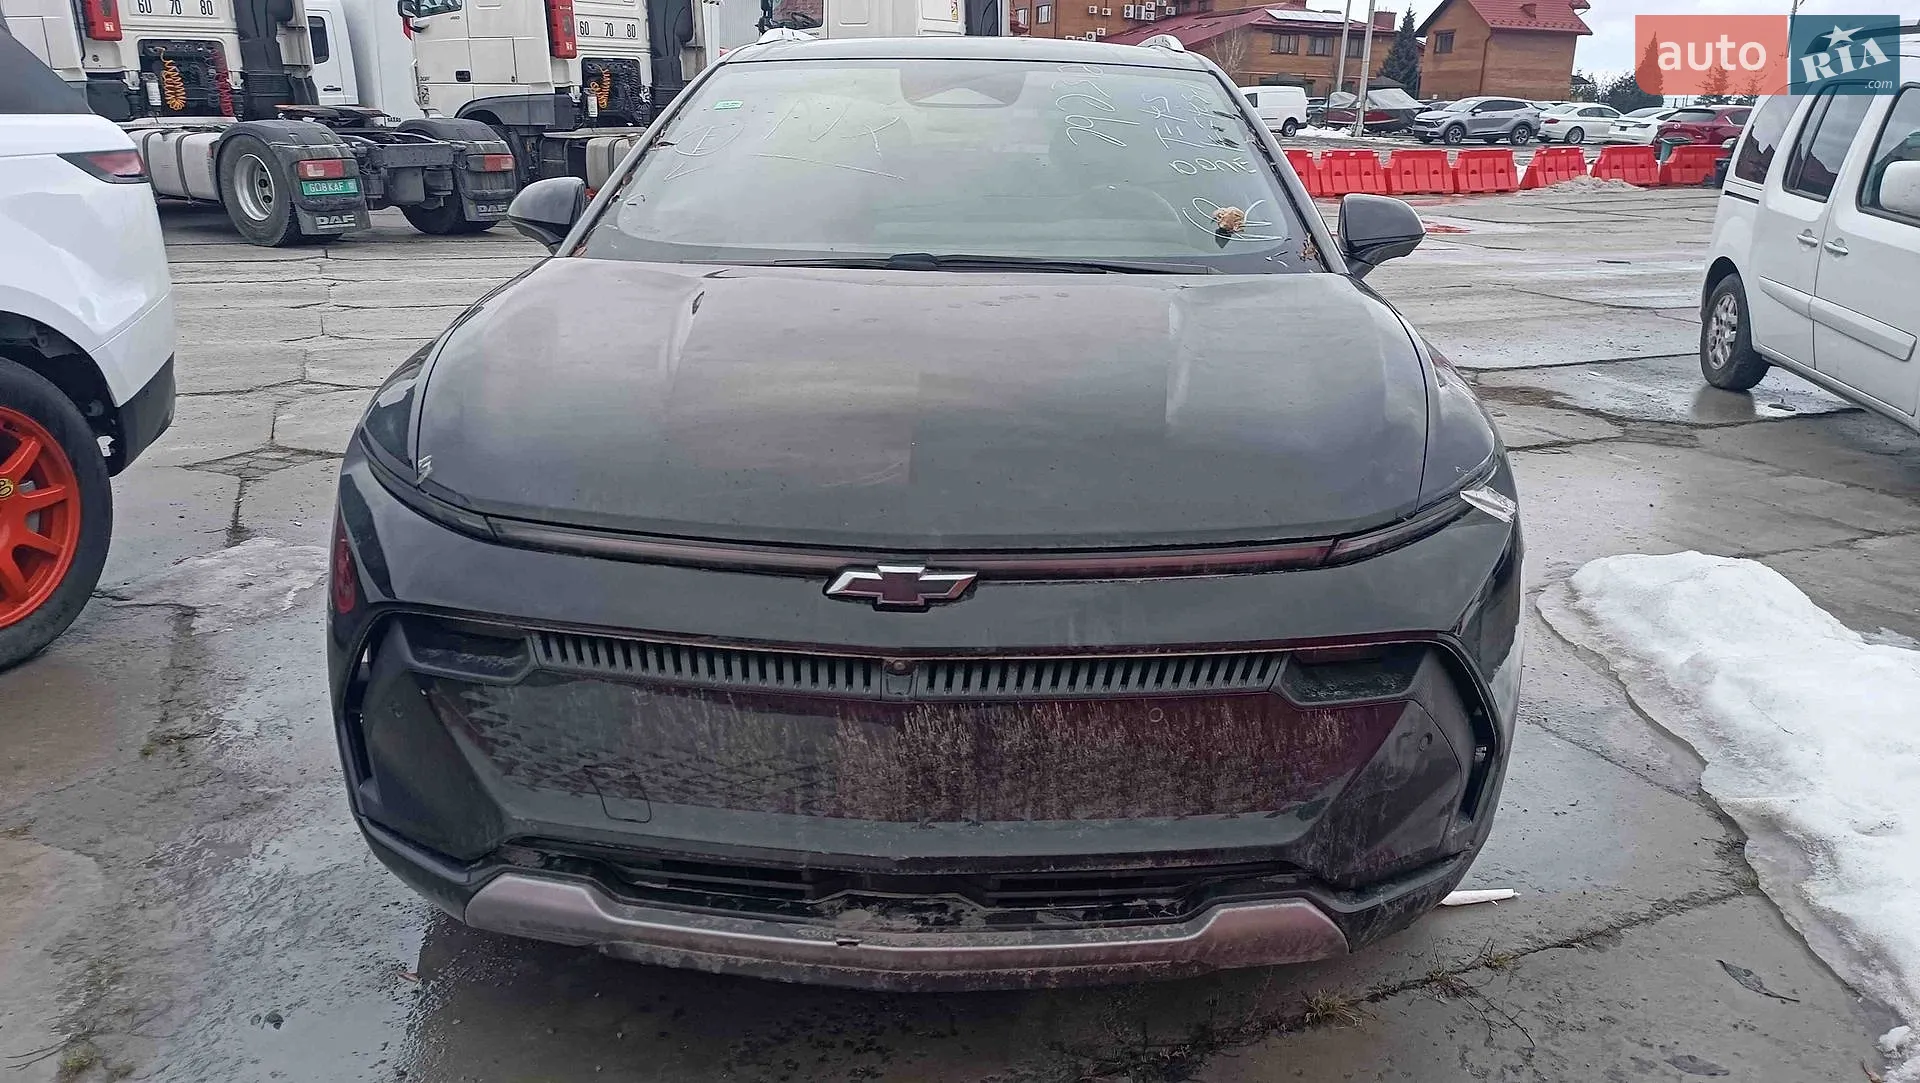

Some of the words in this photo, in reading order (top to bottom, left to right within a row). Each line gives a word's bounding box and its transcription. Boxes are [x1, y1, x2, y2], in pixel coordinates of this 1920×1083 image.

[138, 0, 152, 14] 60
[169, 0, 182, 15] 70
[200, 0, 214, 15] 80
[579, 20, 590, 35] 60
[604, 22, 614, 37] 70
[626, 23, 637, 38] 80
[477, 204, 508, 212] DAF
[315, 214, 355, 225] DAF
